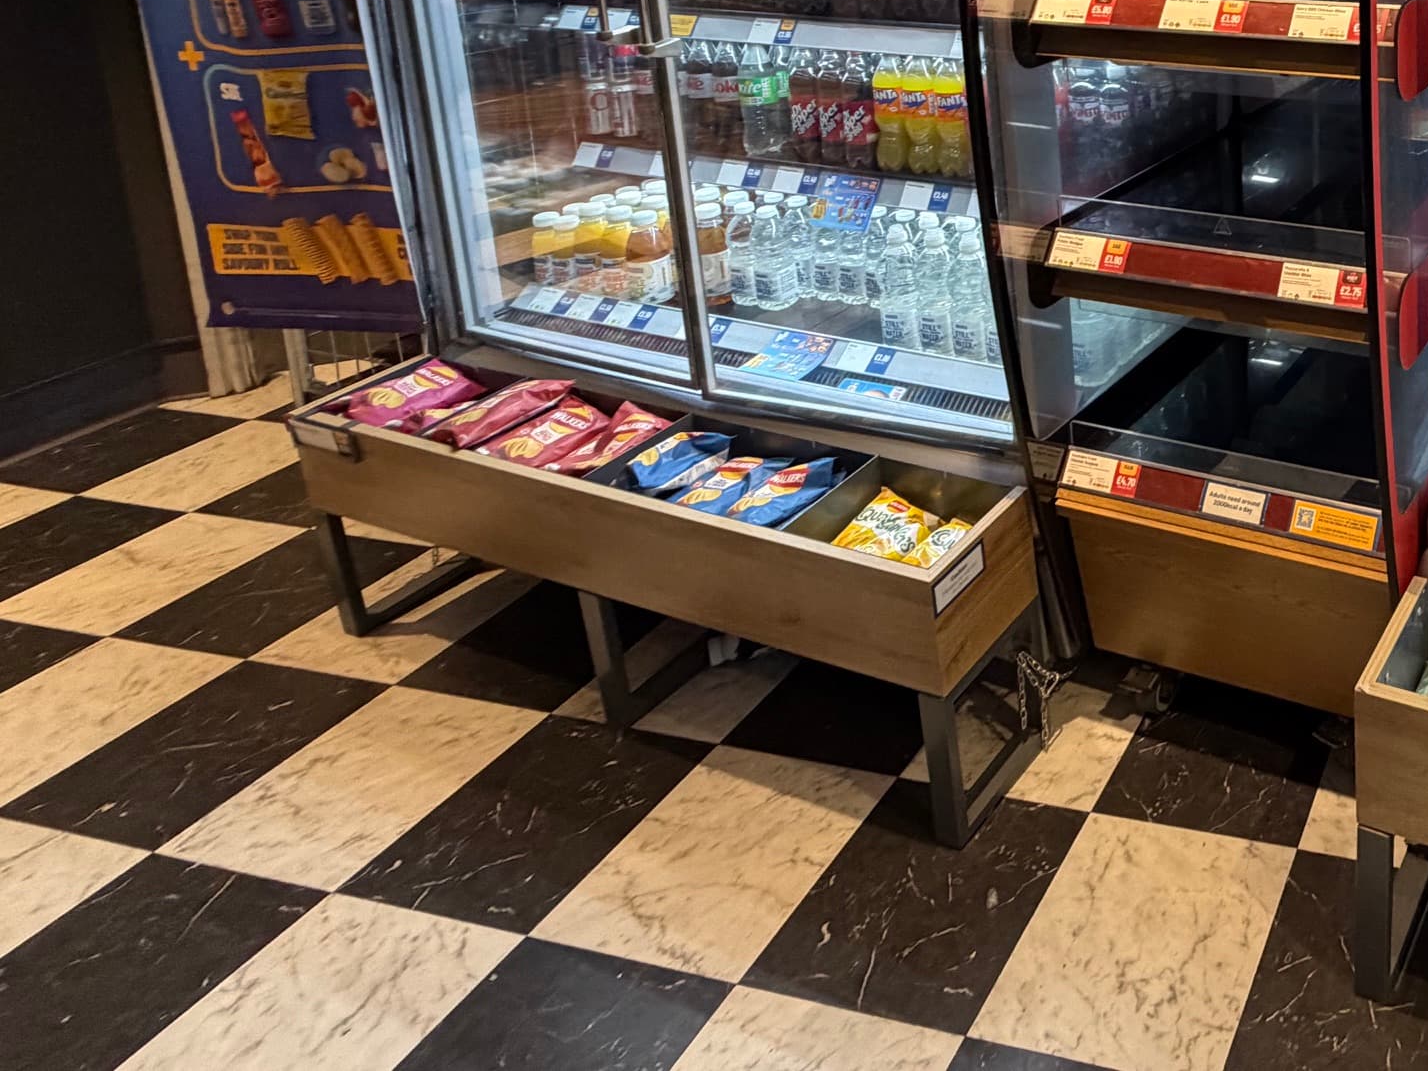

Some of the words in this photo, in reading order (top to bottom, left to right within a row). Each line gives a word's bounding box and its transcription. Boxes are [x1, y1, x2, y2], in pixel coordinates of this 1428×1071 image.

[553, 411, 588, 430] WALKERS
[1209, 490, 1227, 500] Adults
[1227, 494, 1241, 503] need
[1242, 497, 1261, 507] around
[1243, 505, 1253, 514] day
